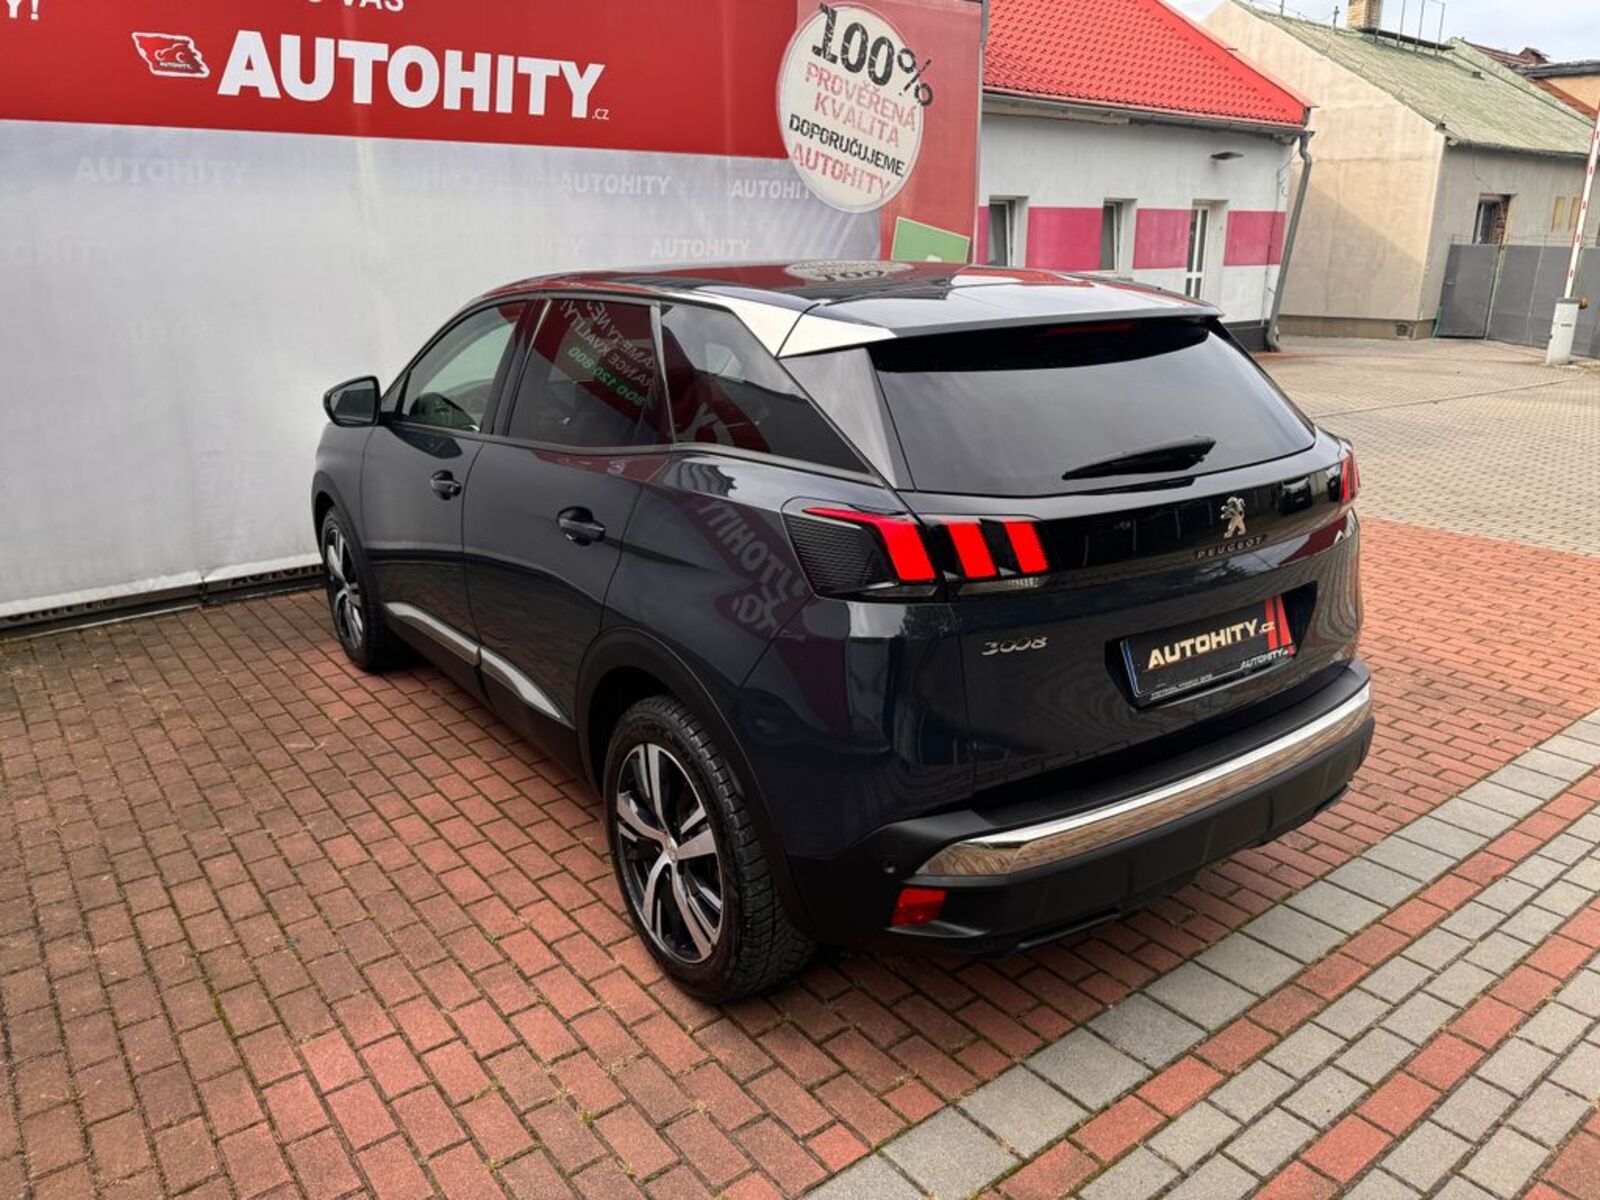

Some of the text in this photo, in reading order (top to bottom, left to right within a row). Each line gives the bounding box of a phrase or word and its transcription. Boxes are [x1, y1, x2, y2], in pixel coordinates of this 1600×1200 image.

[812, 2, 933, 107] 100%
[805, 61, 916, 132] PROVĚŘENÁ
[814, 92, 899, 148] KVALITA
[789, 114, 906, 178] DOPORUČUJEME
[74, 155, 250, 186] AUTOHITY
[559, 172, 672, 196] AUTOHITY
[792, 143, 892, 199] AUTOHITY
[650, 237, 751, 259] AUTOHITY
[1198, 536, 1261, 559] PEUGEOT
[981, 637, 1048, 656] 3008
